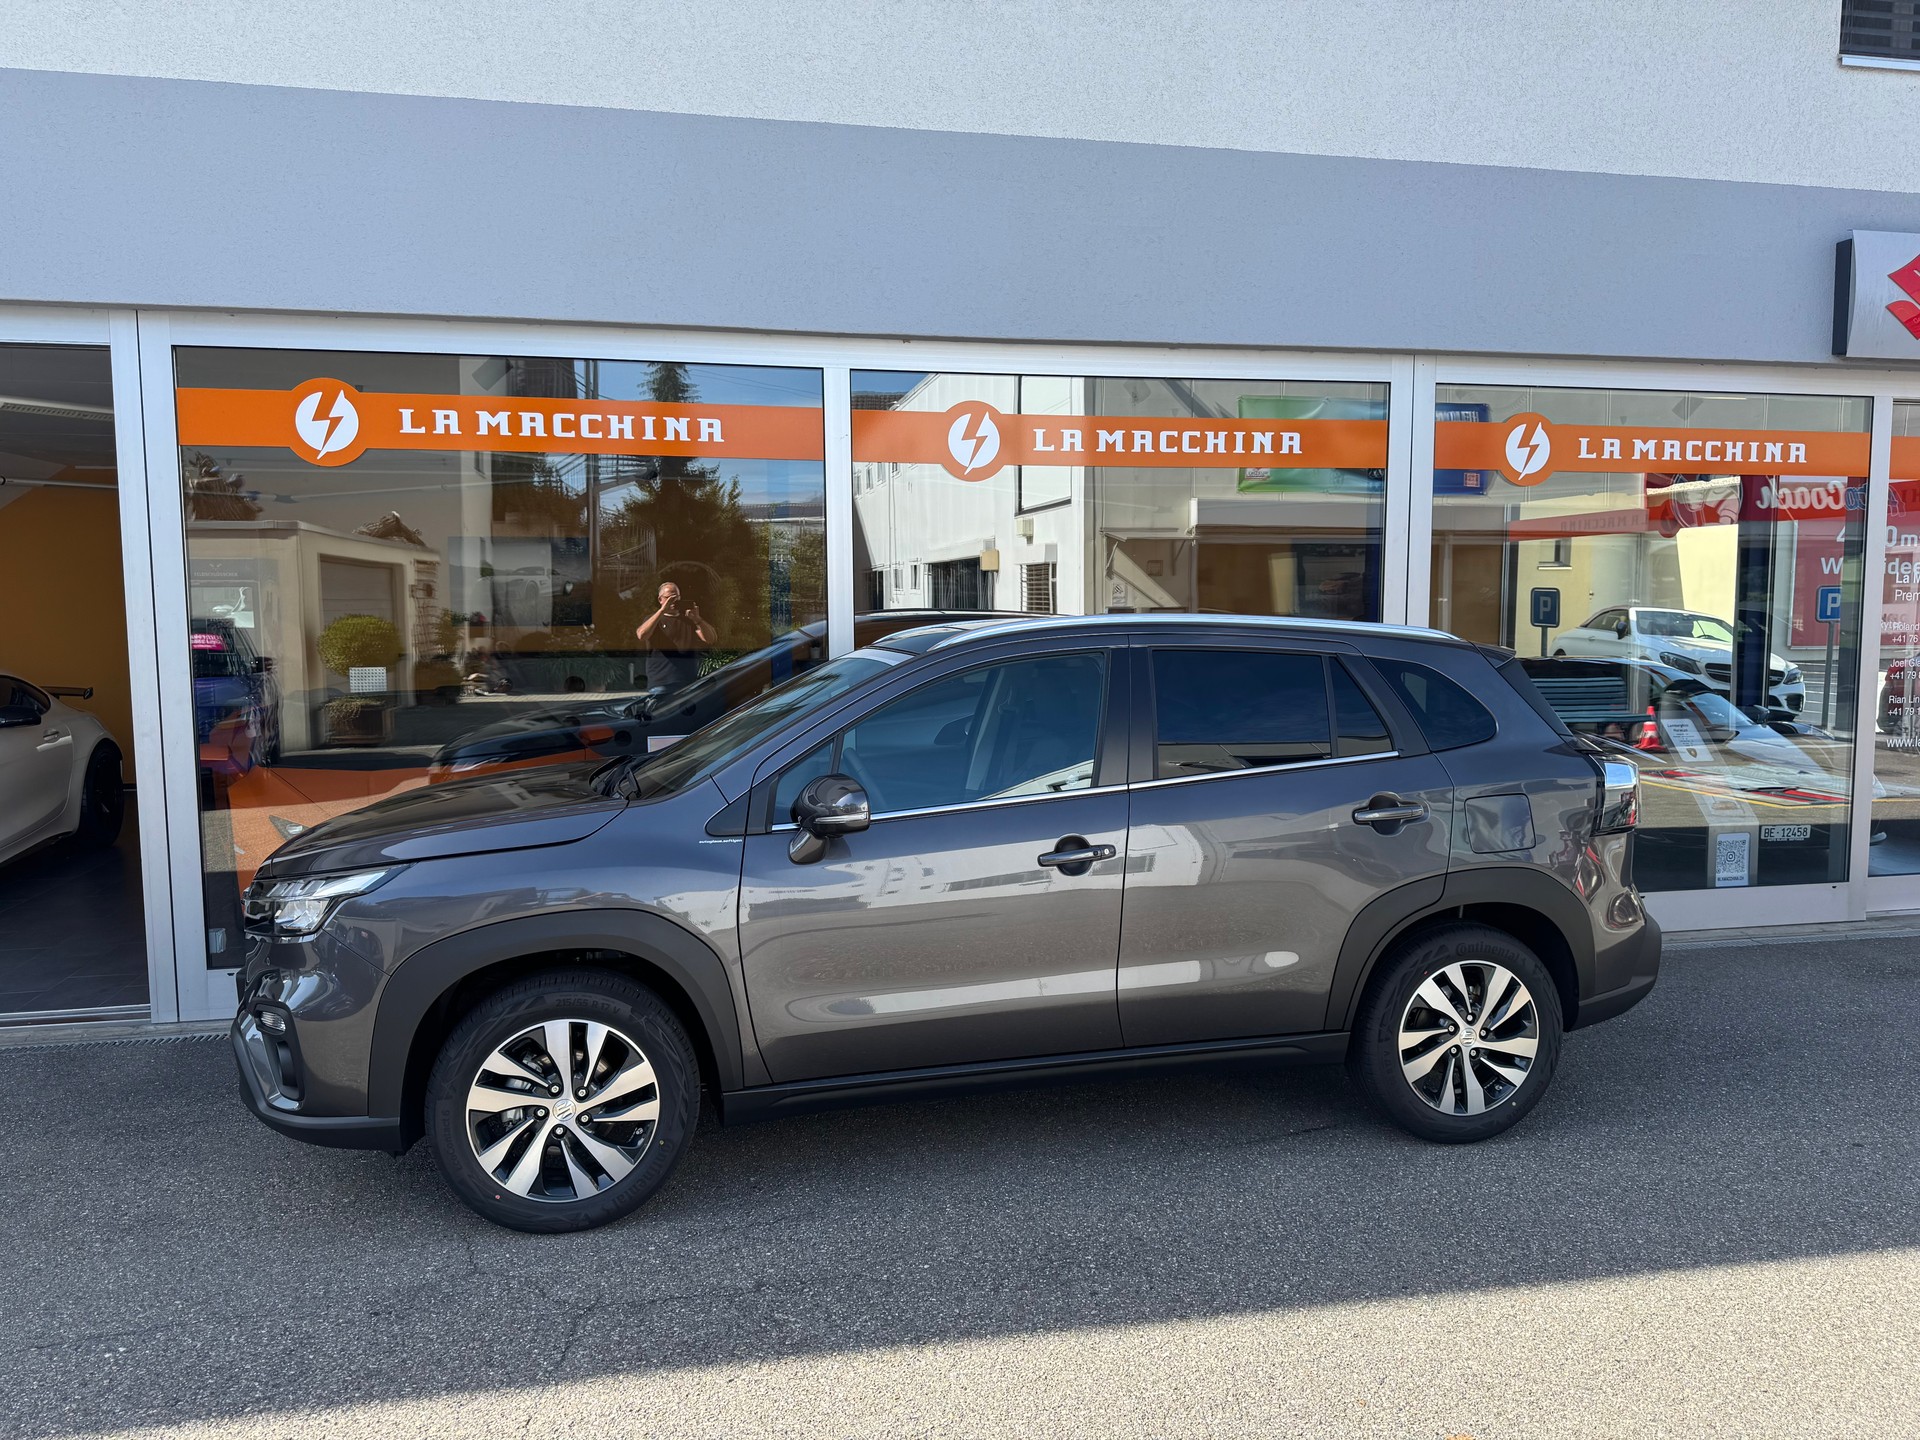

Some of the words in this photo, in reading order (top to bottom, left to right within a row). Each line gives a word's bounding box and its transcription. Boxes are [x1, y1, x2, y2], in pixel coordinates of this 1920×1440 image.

[399, 409, 461, 434] LA
[476, 411, 724, 442] MACCHINA
[1033, 429, 1084, 451] LA
[1096, 430, 1302, 453] MACCHINA
[1578, 438, 1621, 459] LA
[1632, 440, 1806, 462] MACCHINA
[1895, 572, 1910, 584] La
[1540, 596, 1552, 620] P
[1892, 634, 1906, 643] +41
[1890, 658, 1907, 668] Joel
[1889, 671, 1904, 680] +41
[1907, 671, 1917, 680] 79
[1888, 695, 1906, 704] Rian
[1887, 707, 1902, 716] +41
[1904, 707, 1915, 716] 79
[555, 997, 588, 1008] 215/55
[591, 1000, 599, 1009] R
